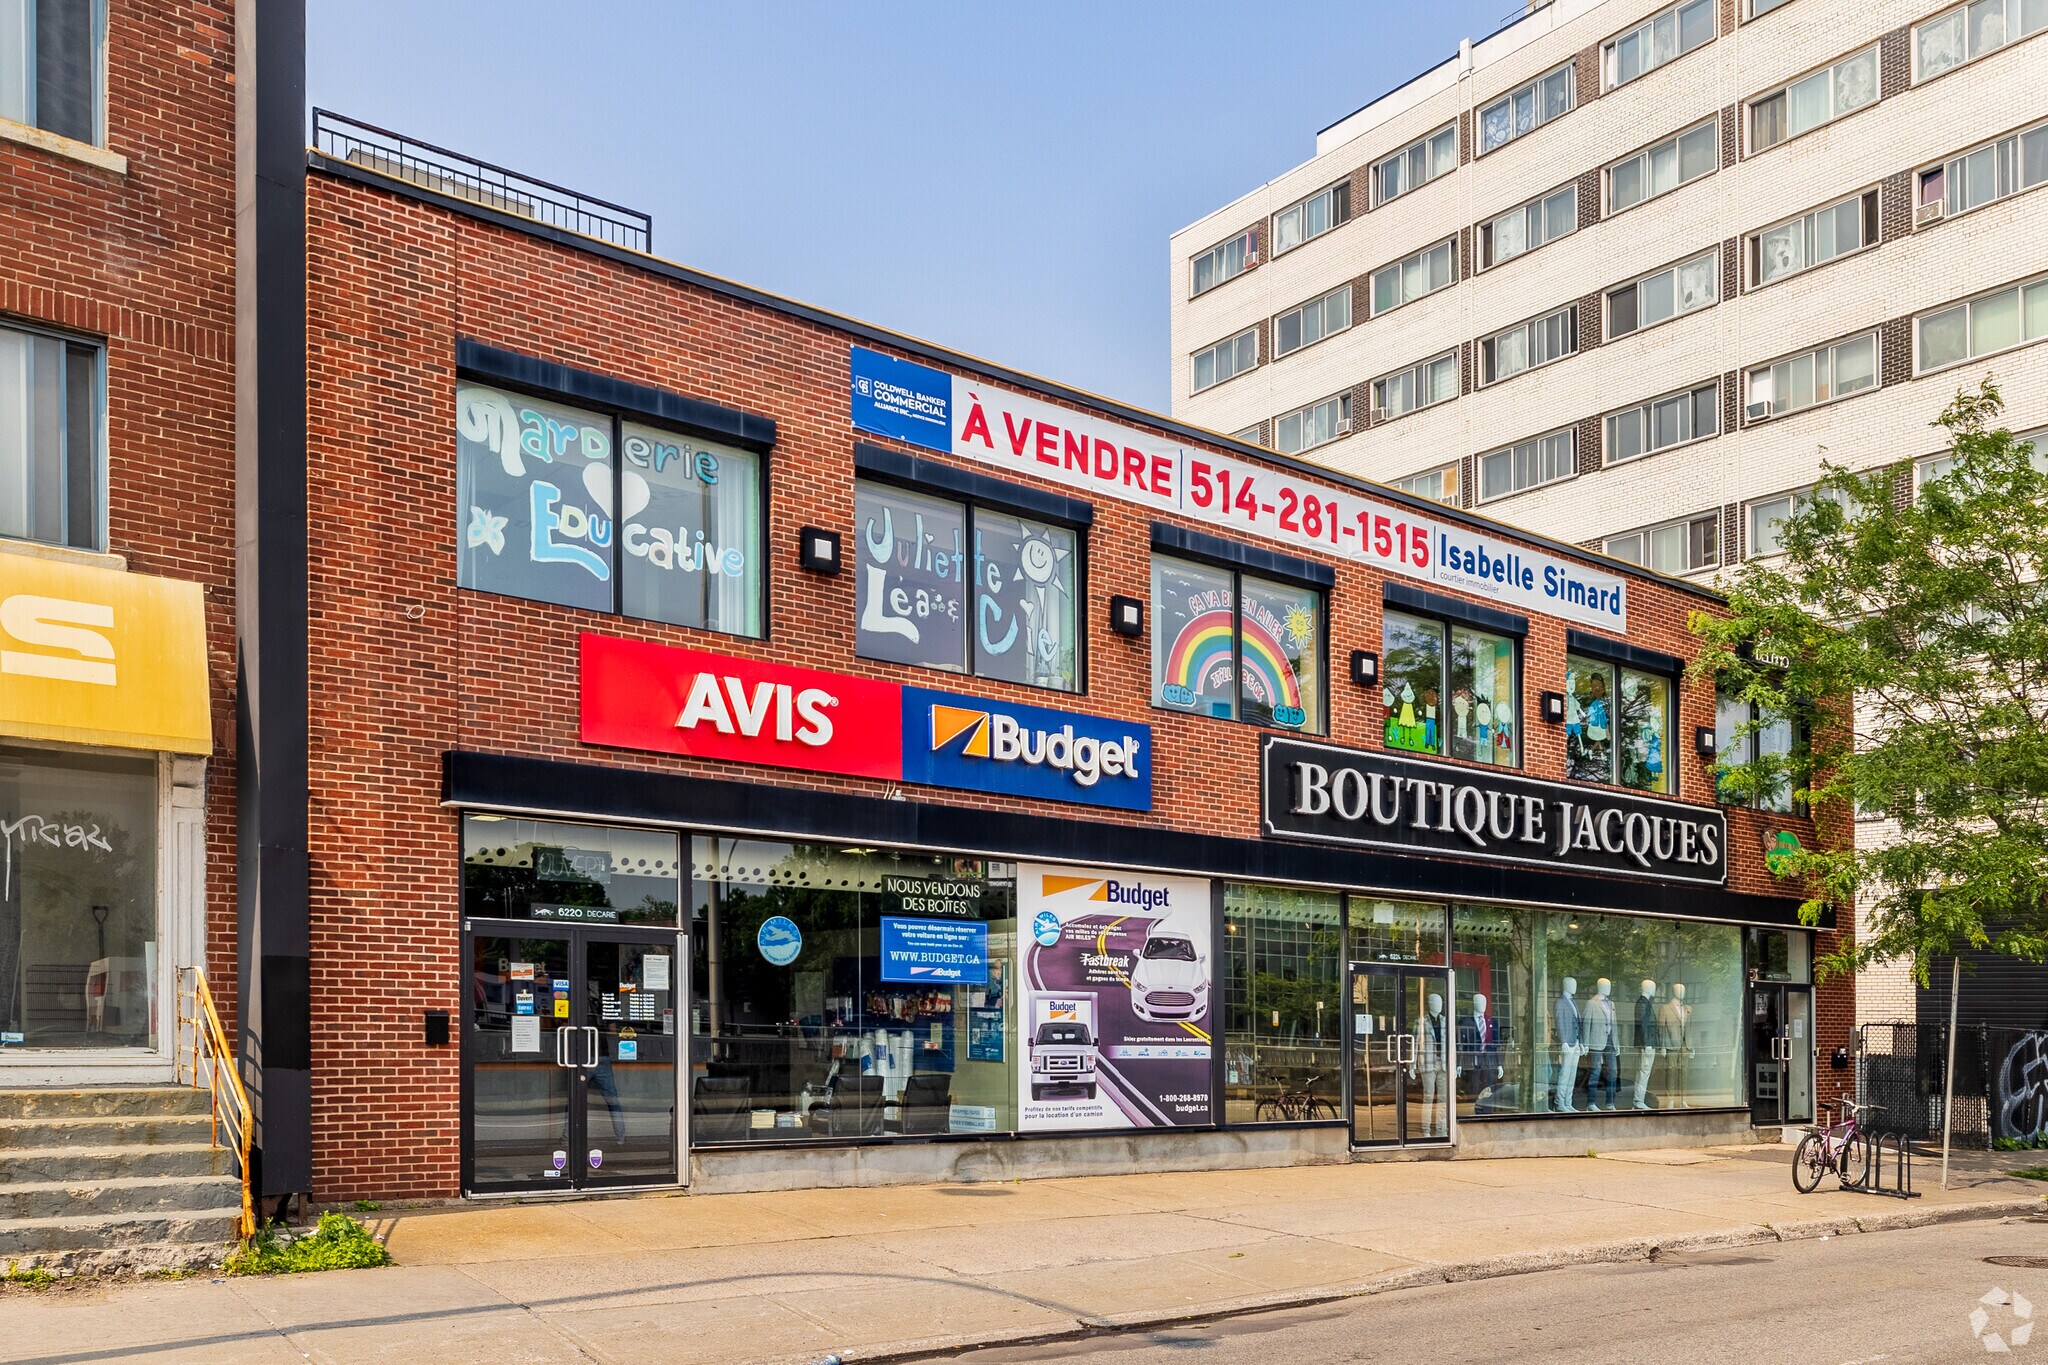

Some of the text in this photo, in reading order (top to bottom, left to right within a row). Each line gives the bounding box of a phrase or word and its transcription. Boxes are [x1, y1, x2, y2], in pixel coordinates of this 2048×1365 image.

[874, 381, 947, 408] COLDWELL BANKER
[874, 389, 947, 418] COMMERCIAL
[874, 401, 900, 414] ALLIANCE
[961, 392, 1172, 497] À VENDRE
[1191, 460, 1429, 568] 514-281-1515
[1440, 533, 1620, 616] Isabelle Simard
[1440, 572, 1499, 594] courtier immobilier
[1188, 593, 1206, 616] ÇA
[1202, 589, 1221, 611] VA
[1255, 604, 1284, 643] ALLER
[1242, 669, 1256, 690] BE
[1252, 680, 1266, 702] OK
[675, 672, 834, 746] AVIS
[992, 713, 1138, 787] Budget
[1294, 761, 1718, 867] BOUTIQUE JACQUES
[887, 878, 921, 895] NOUS
[923, 881, 980, 898] VENDONS
[1107, 879, 1170, 911] Budget
[558, 907, 617, 919] 6220 DECARIE
[903, 896, 967, 915] DES BOÎTES
[893, 922, 977, 934] Vous pouvez désormais réserver
[944, 932, 957, 942] ligne
[889, 950, 980, 965] WWW.BUDGET.CA
[1079, 952, 1130, 967] Fastbreak
[938, 967, 961, 979] Budget
[1050, 1001, 1077, 1013] Budget
[1159, 1094, 1208, 1103] 1-800-268-8970
[1175, 1104, 1208, 1113] budget.ca
